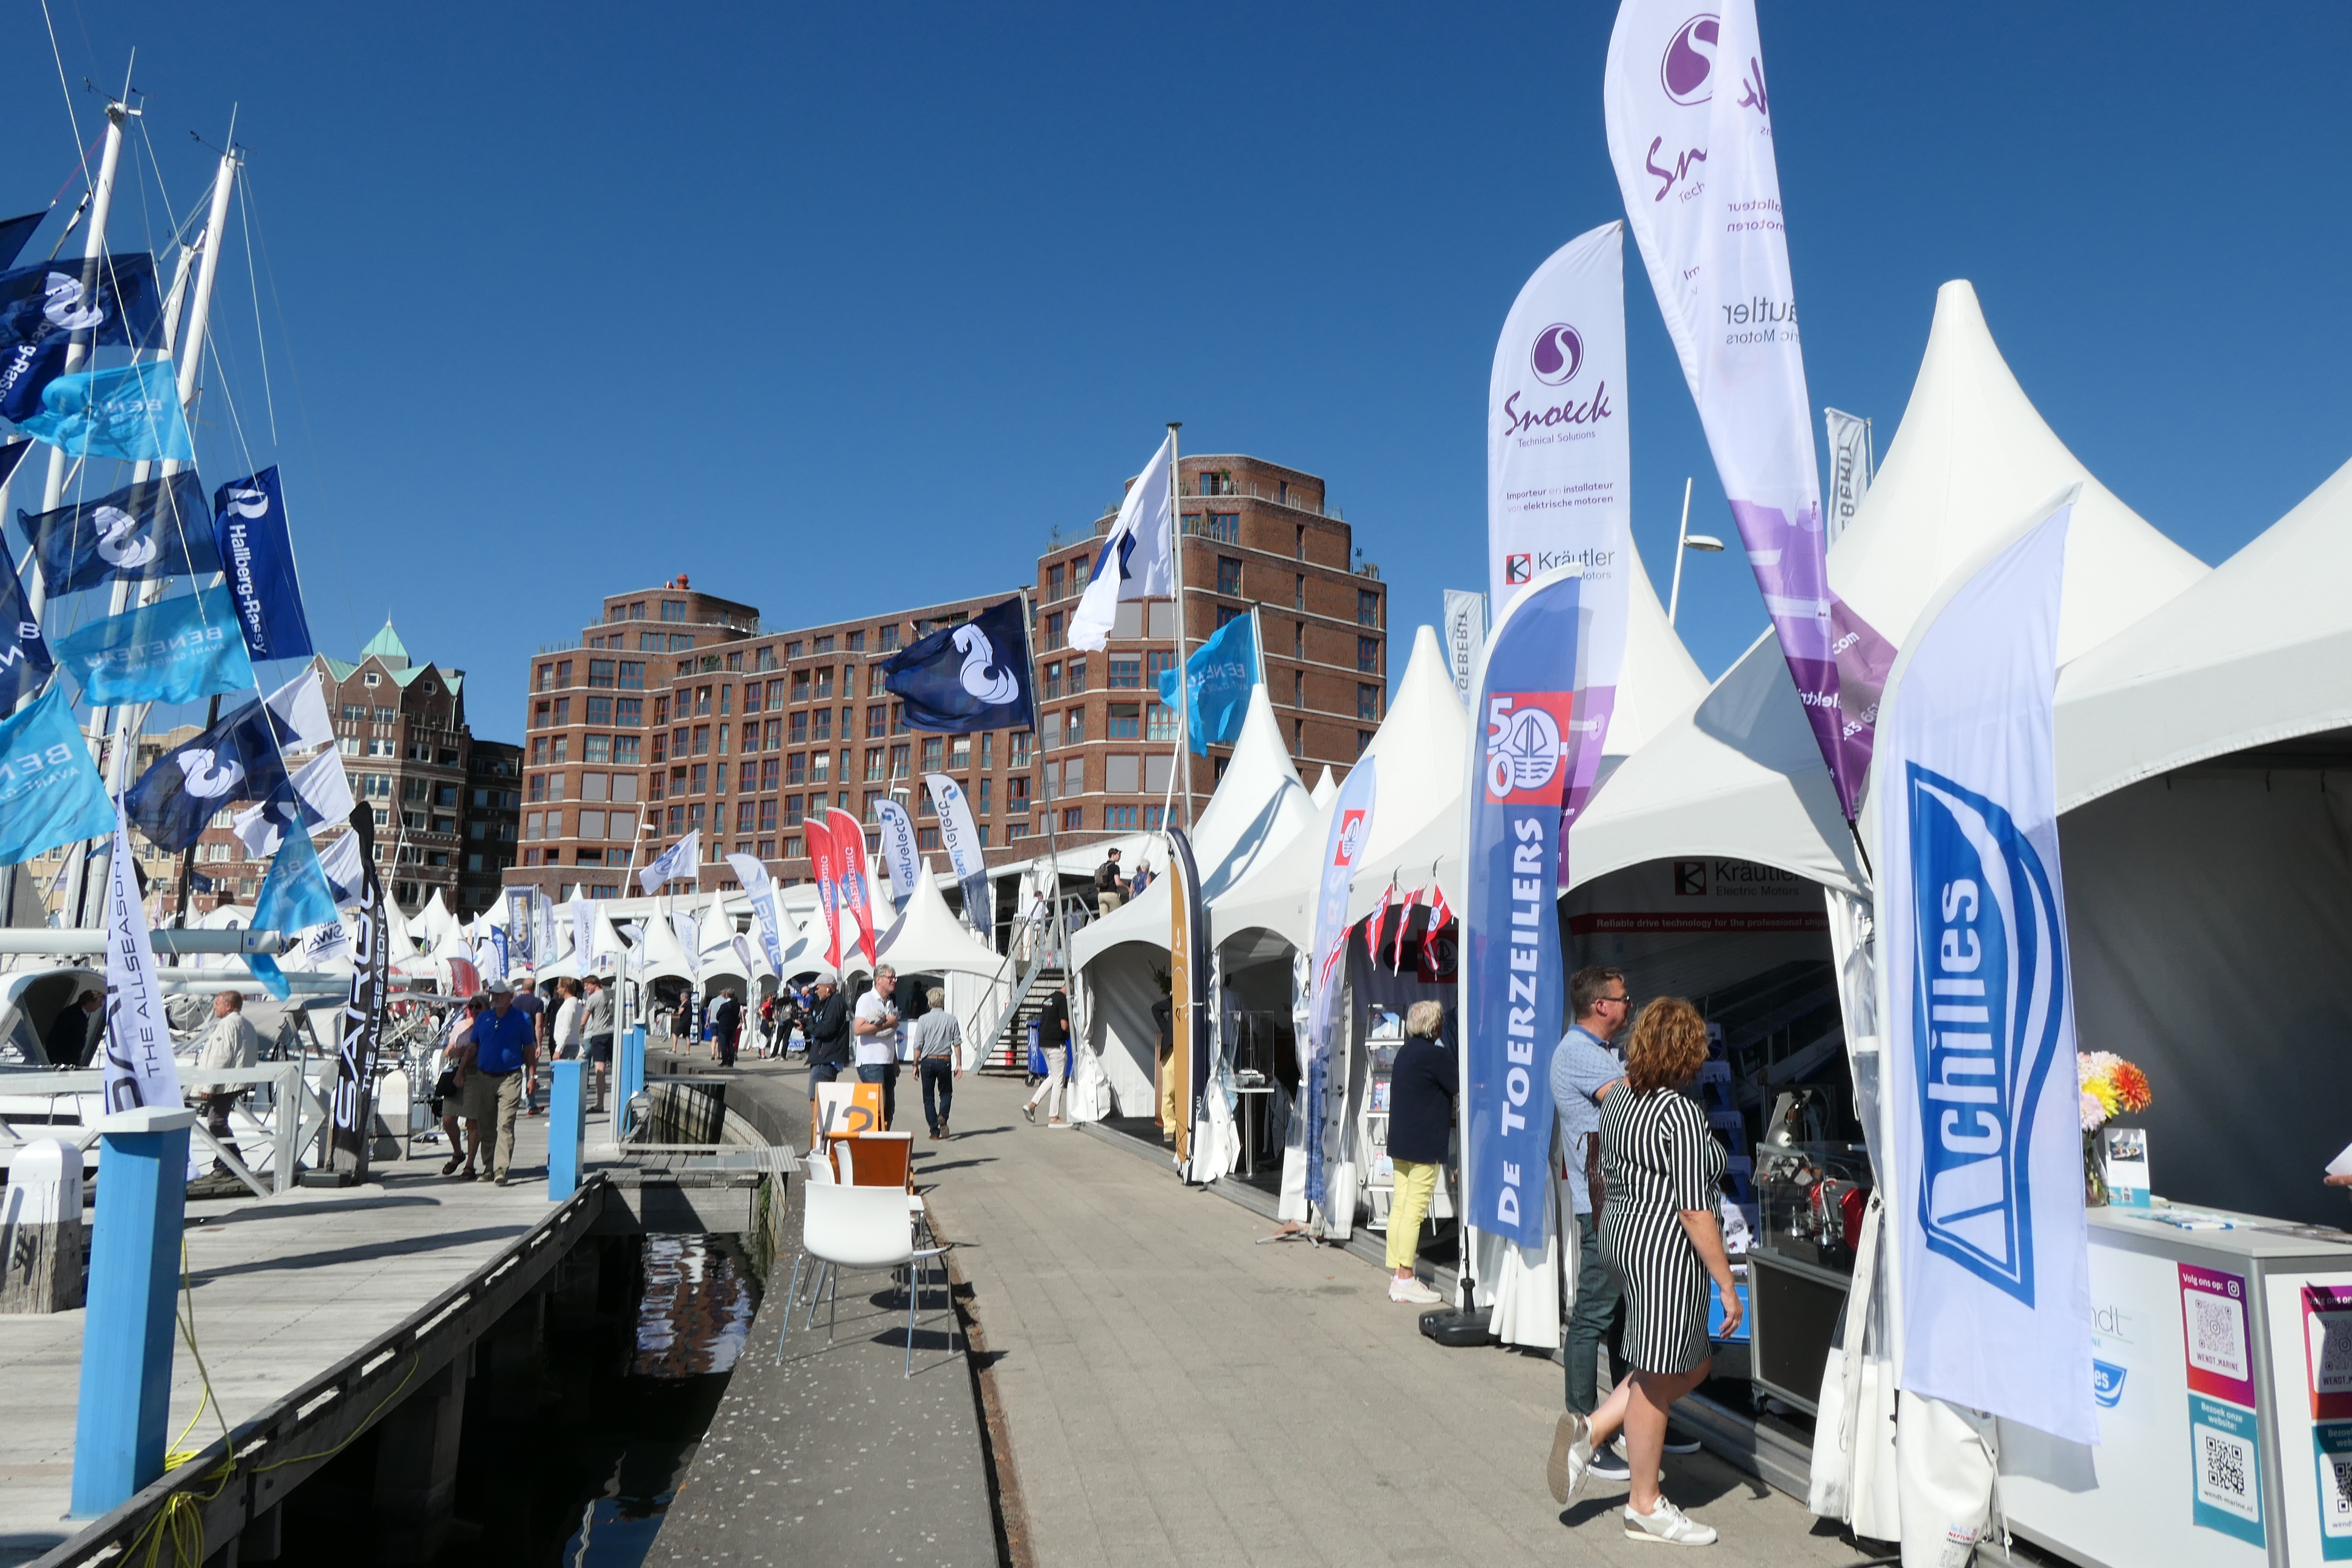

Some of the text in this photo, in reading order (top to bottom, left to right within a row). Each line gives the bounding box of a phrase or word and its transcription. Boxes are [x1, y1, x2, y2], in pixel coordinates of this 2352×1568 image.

[1504, 381, 1611, 437] Snoeck
[1518, 429, 1595, 448] Technical Solutions
[1507, 487, 1547, 501] Importeur
[1563, 481, 1613, 494] installateur
[1523, 498, 1572, 511] elektrische
[1574, 495, 1613, 506] motoren
[229, 524, 267, 654] Hallberg-Rassy
[893, 817, 914, 887] sailselect
[1717, 885, 1799, 897] Electric Motors
[1596, 918, 1829, 928] Reliable drive technology for the professional shipp
[115, 861, 150, 1019] ALLSEASON
[362, 924, 385, 1093] THE ALLSEASON
[1498, 817, 1543, 1227] DE TOERZEILERS
[140, 1027, 160, 1078] THE
[1927, 878, 2008, 1265] Achilles
[2183, 1273, 2223, 1291] Volg ons op:
[2308, 1296, 2325, 1305] Volg
[2342, 1296, 2352, 1305] op
[2201, 1401, 2243, 1424] Bezoek onze
[2208, 1416, 2237, 1431] website:
[2204, 1489, 2253, 1513] wendt-marine.nl
